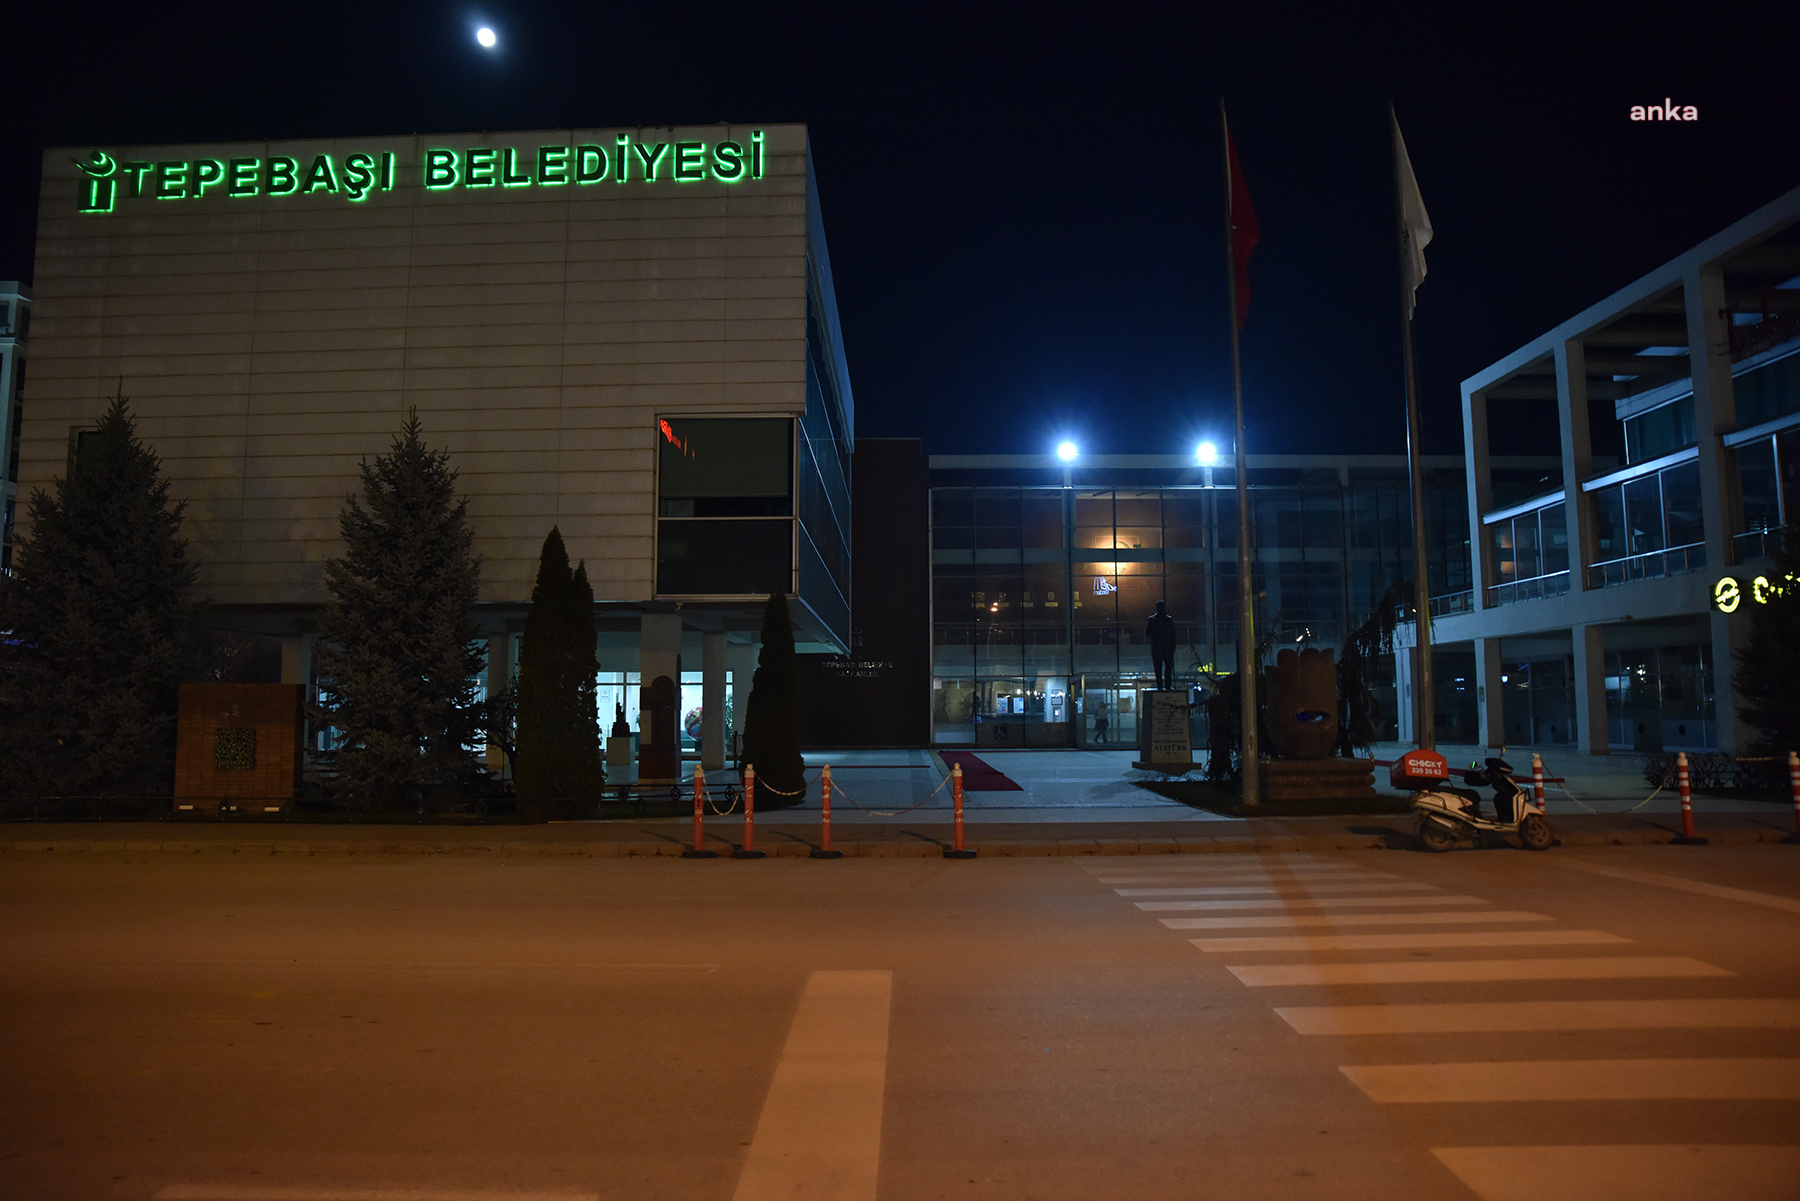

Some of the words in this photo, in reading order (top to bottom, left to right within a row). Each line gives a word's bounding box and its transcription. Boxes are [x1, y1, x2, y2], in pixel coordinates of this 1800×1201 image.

[122, 152, 395, 201] TEPEBAŞI
[424, 131, 764, 189] BELEDİYESİ
[1408, 759, 1443, 768] CHICKY
